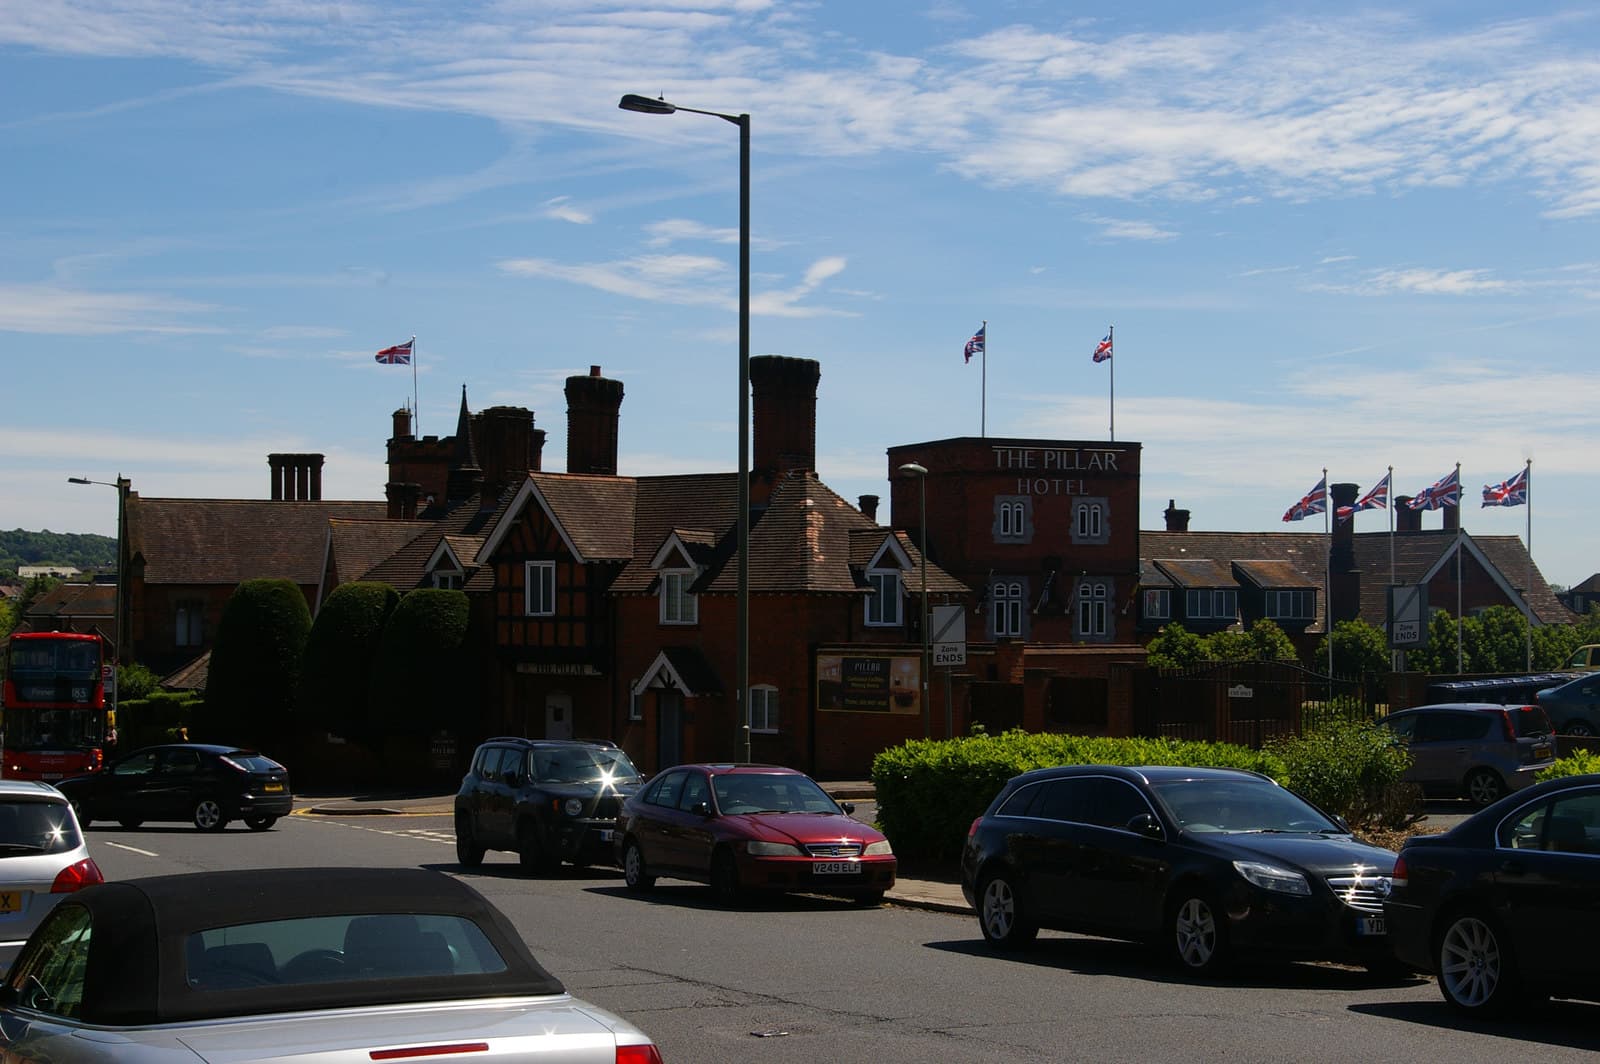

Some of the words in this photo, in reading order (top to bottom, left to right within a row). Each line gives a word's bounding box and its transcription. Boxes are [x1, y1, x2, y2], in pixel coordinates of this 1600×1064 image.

[992, 449, 1037, 470] THE
[1043, 450, 1118, 471] PILLAR
[1017, 478, 1089, 496] HOTEL
[1395, 631, 1417, 641] ENDS
[936, 654, 963, 663] ENDS
[814, 863, 840, 873] V249
[1367, 919, 1386, 933] YD
